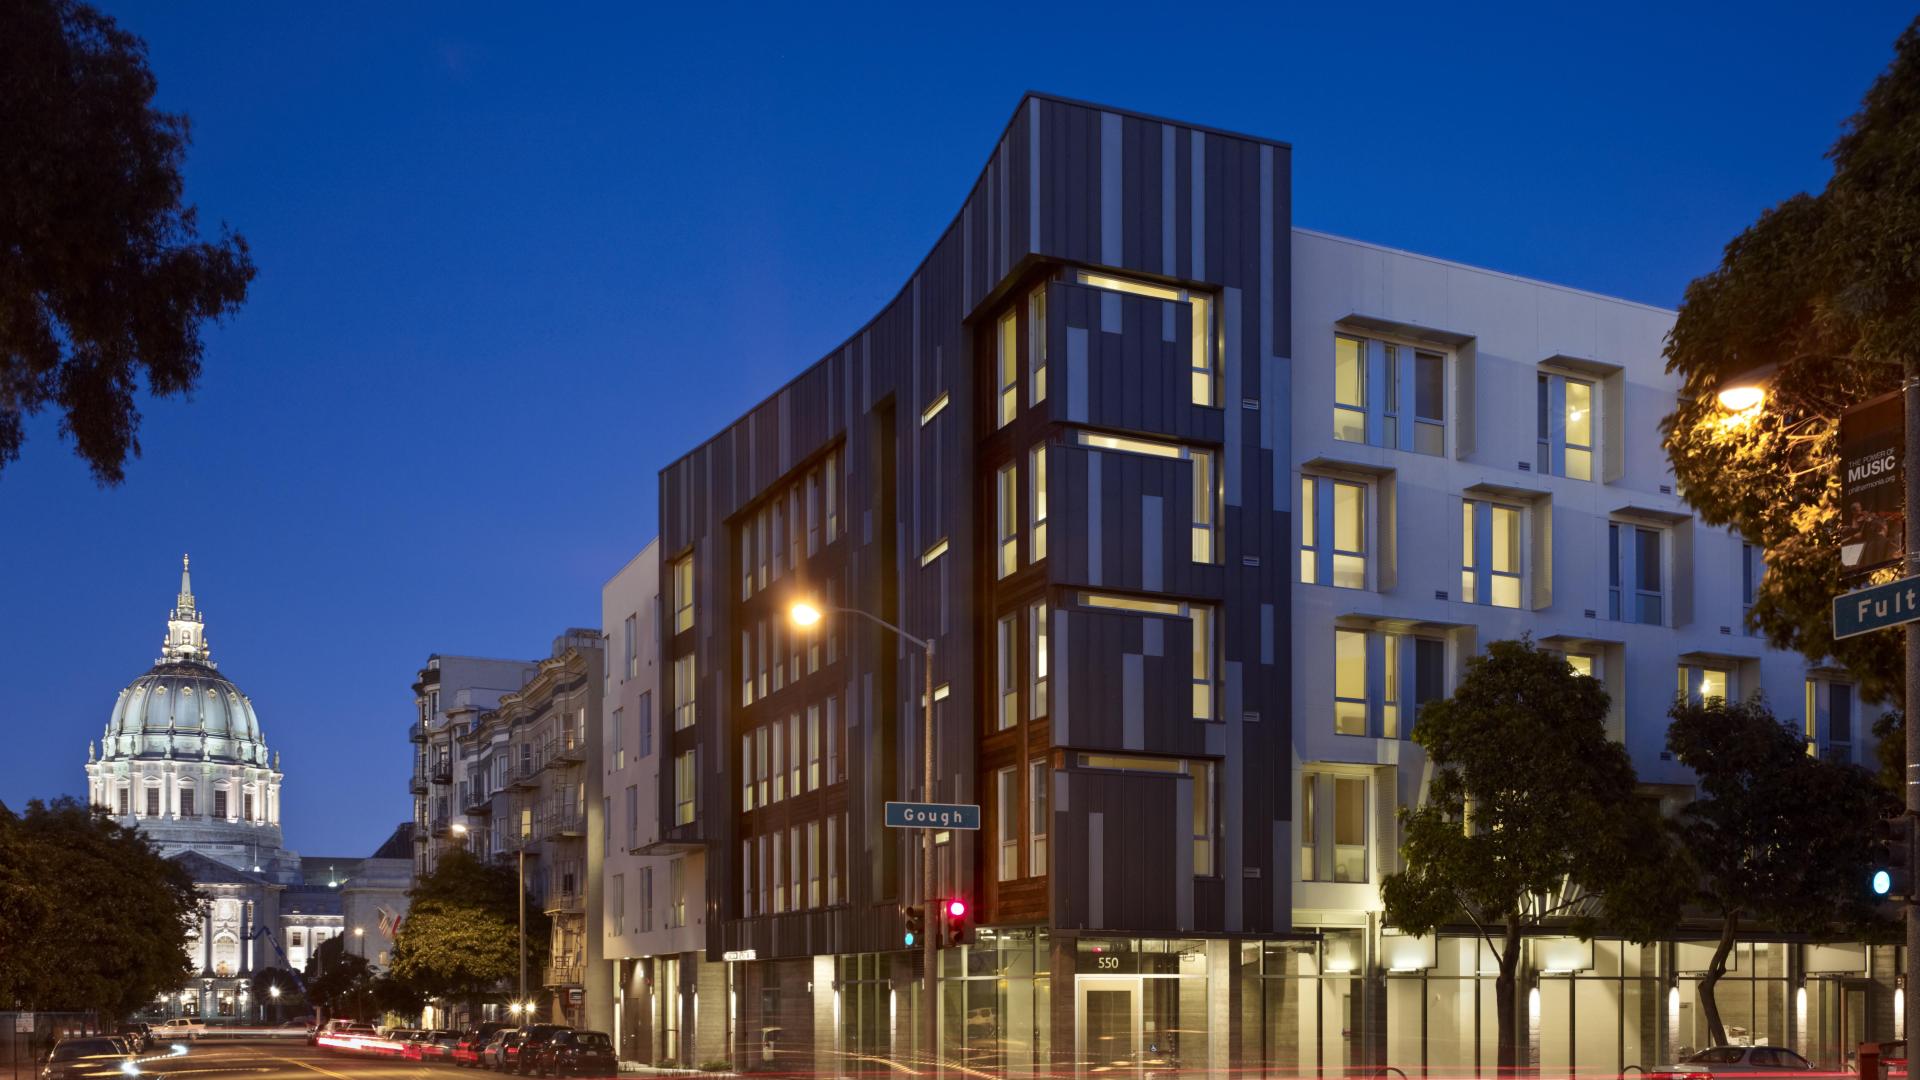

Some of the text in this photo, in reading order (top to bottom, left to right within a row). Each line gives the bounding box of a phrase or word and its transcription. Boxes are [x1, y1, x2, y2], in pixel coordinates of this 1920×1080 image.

[1849, 447, 1896, 468] THE POWER OF
[1848, 455, 1896, 483] MUSIC
[903, 808, 963, 826] Gough
[1098, 957, 1119, 969] 550
